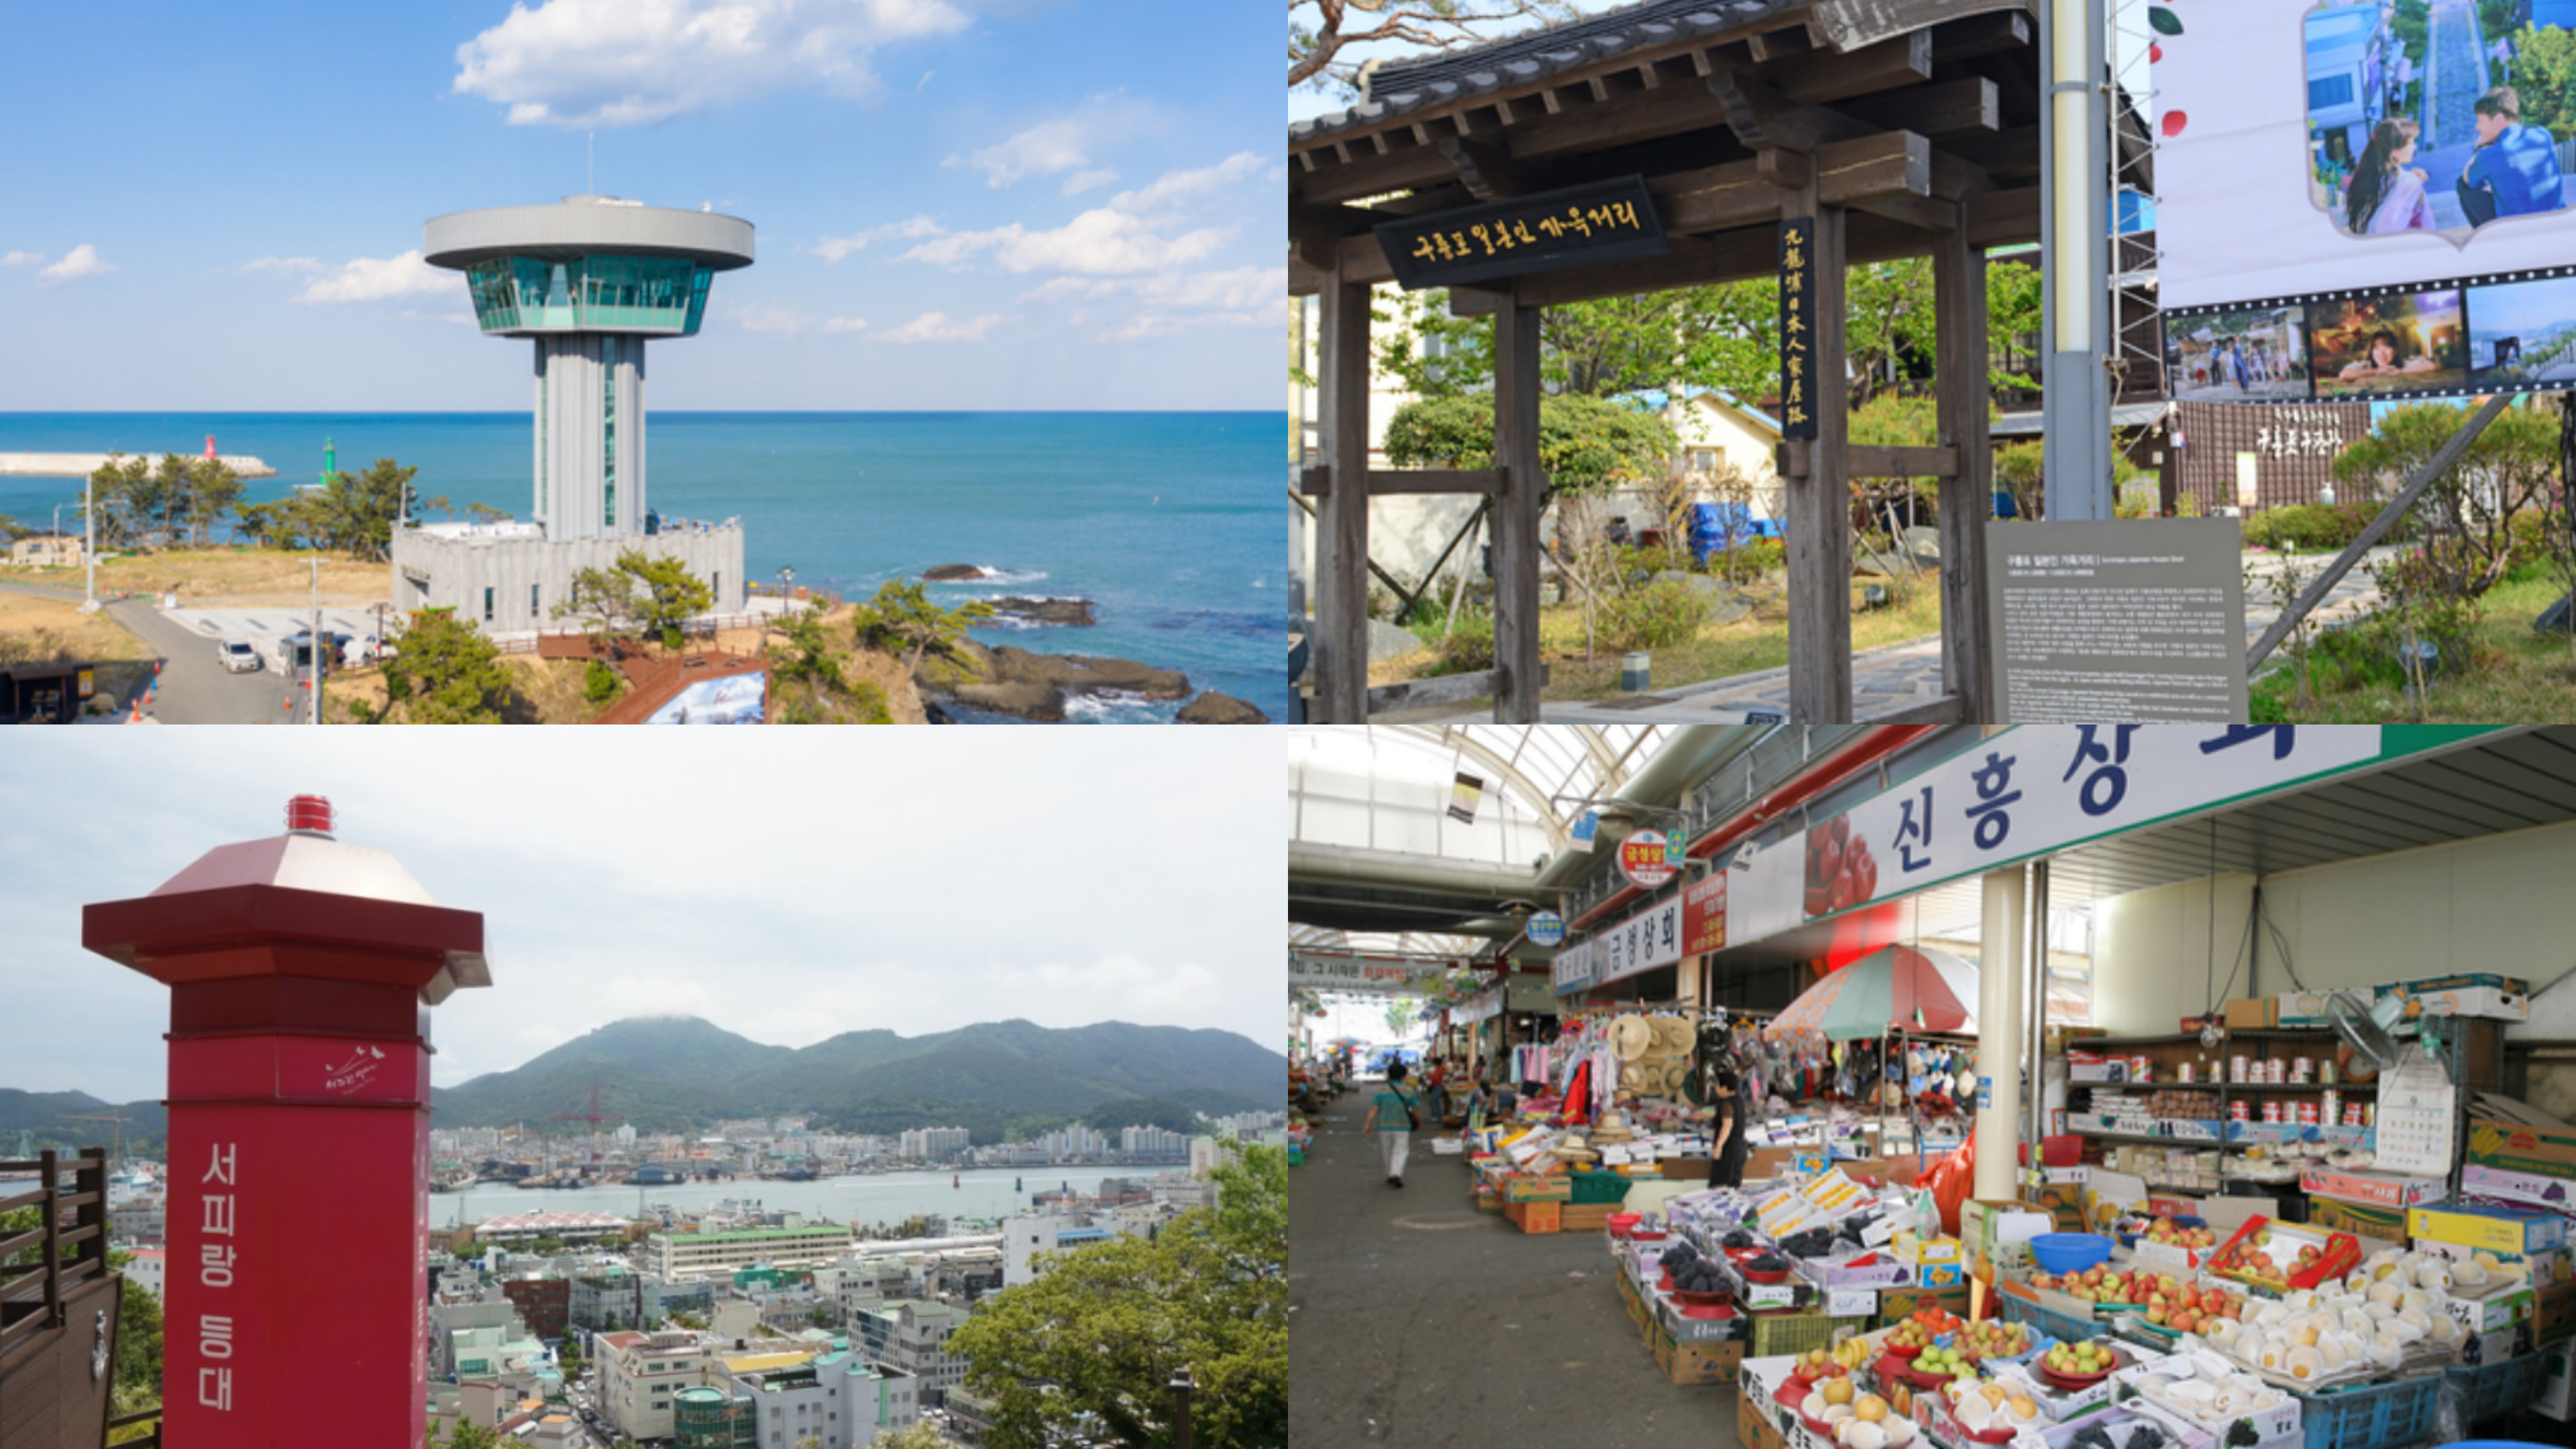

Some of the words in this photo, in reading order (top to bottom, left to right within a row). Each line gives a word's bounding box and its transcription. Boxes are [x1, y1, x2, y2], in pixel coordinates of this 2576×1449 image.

[1412, 232, 1472, 262] 구룡포
[1470, 219, 1537, 256] 일본인
[201, 1142, 237, 1287] 서피랑
[199, 1314, 233, 1411] 등대
